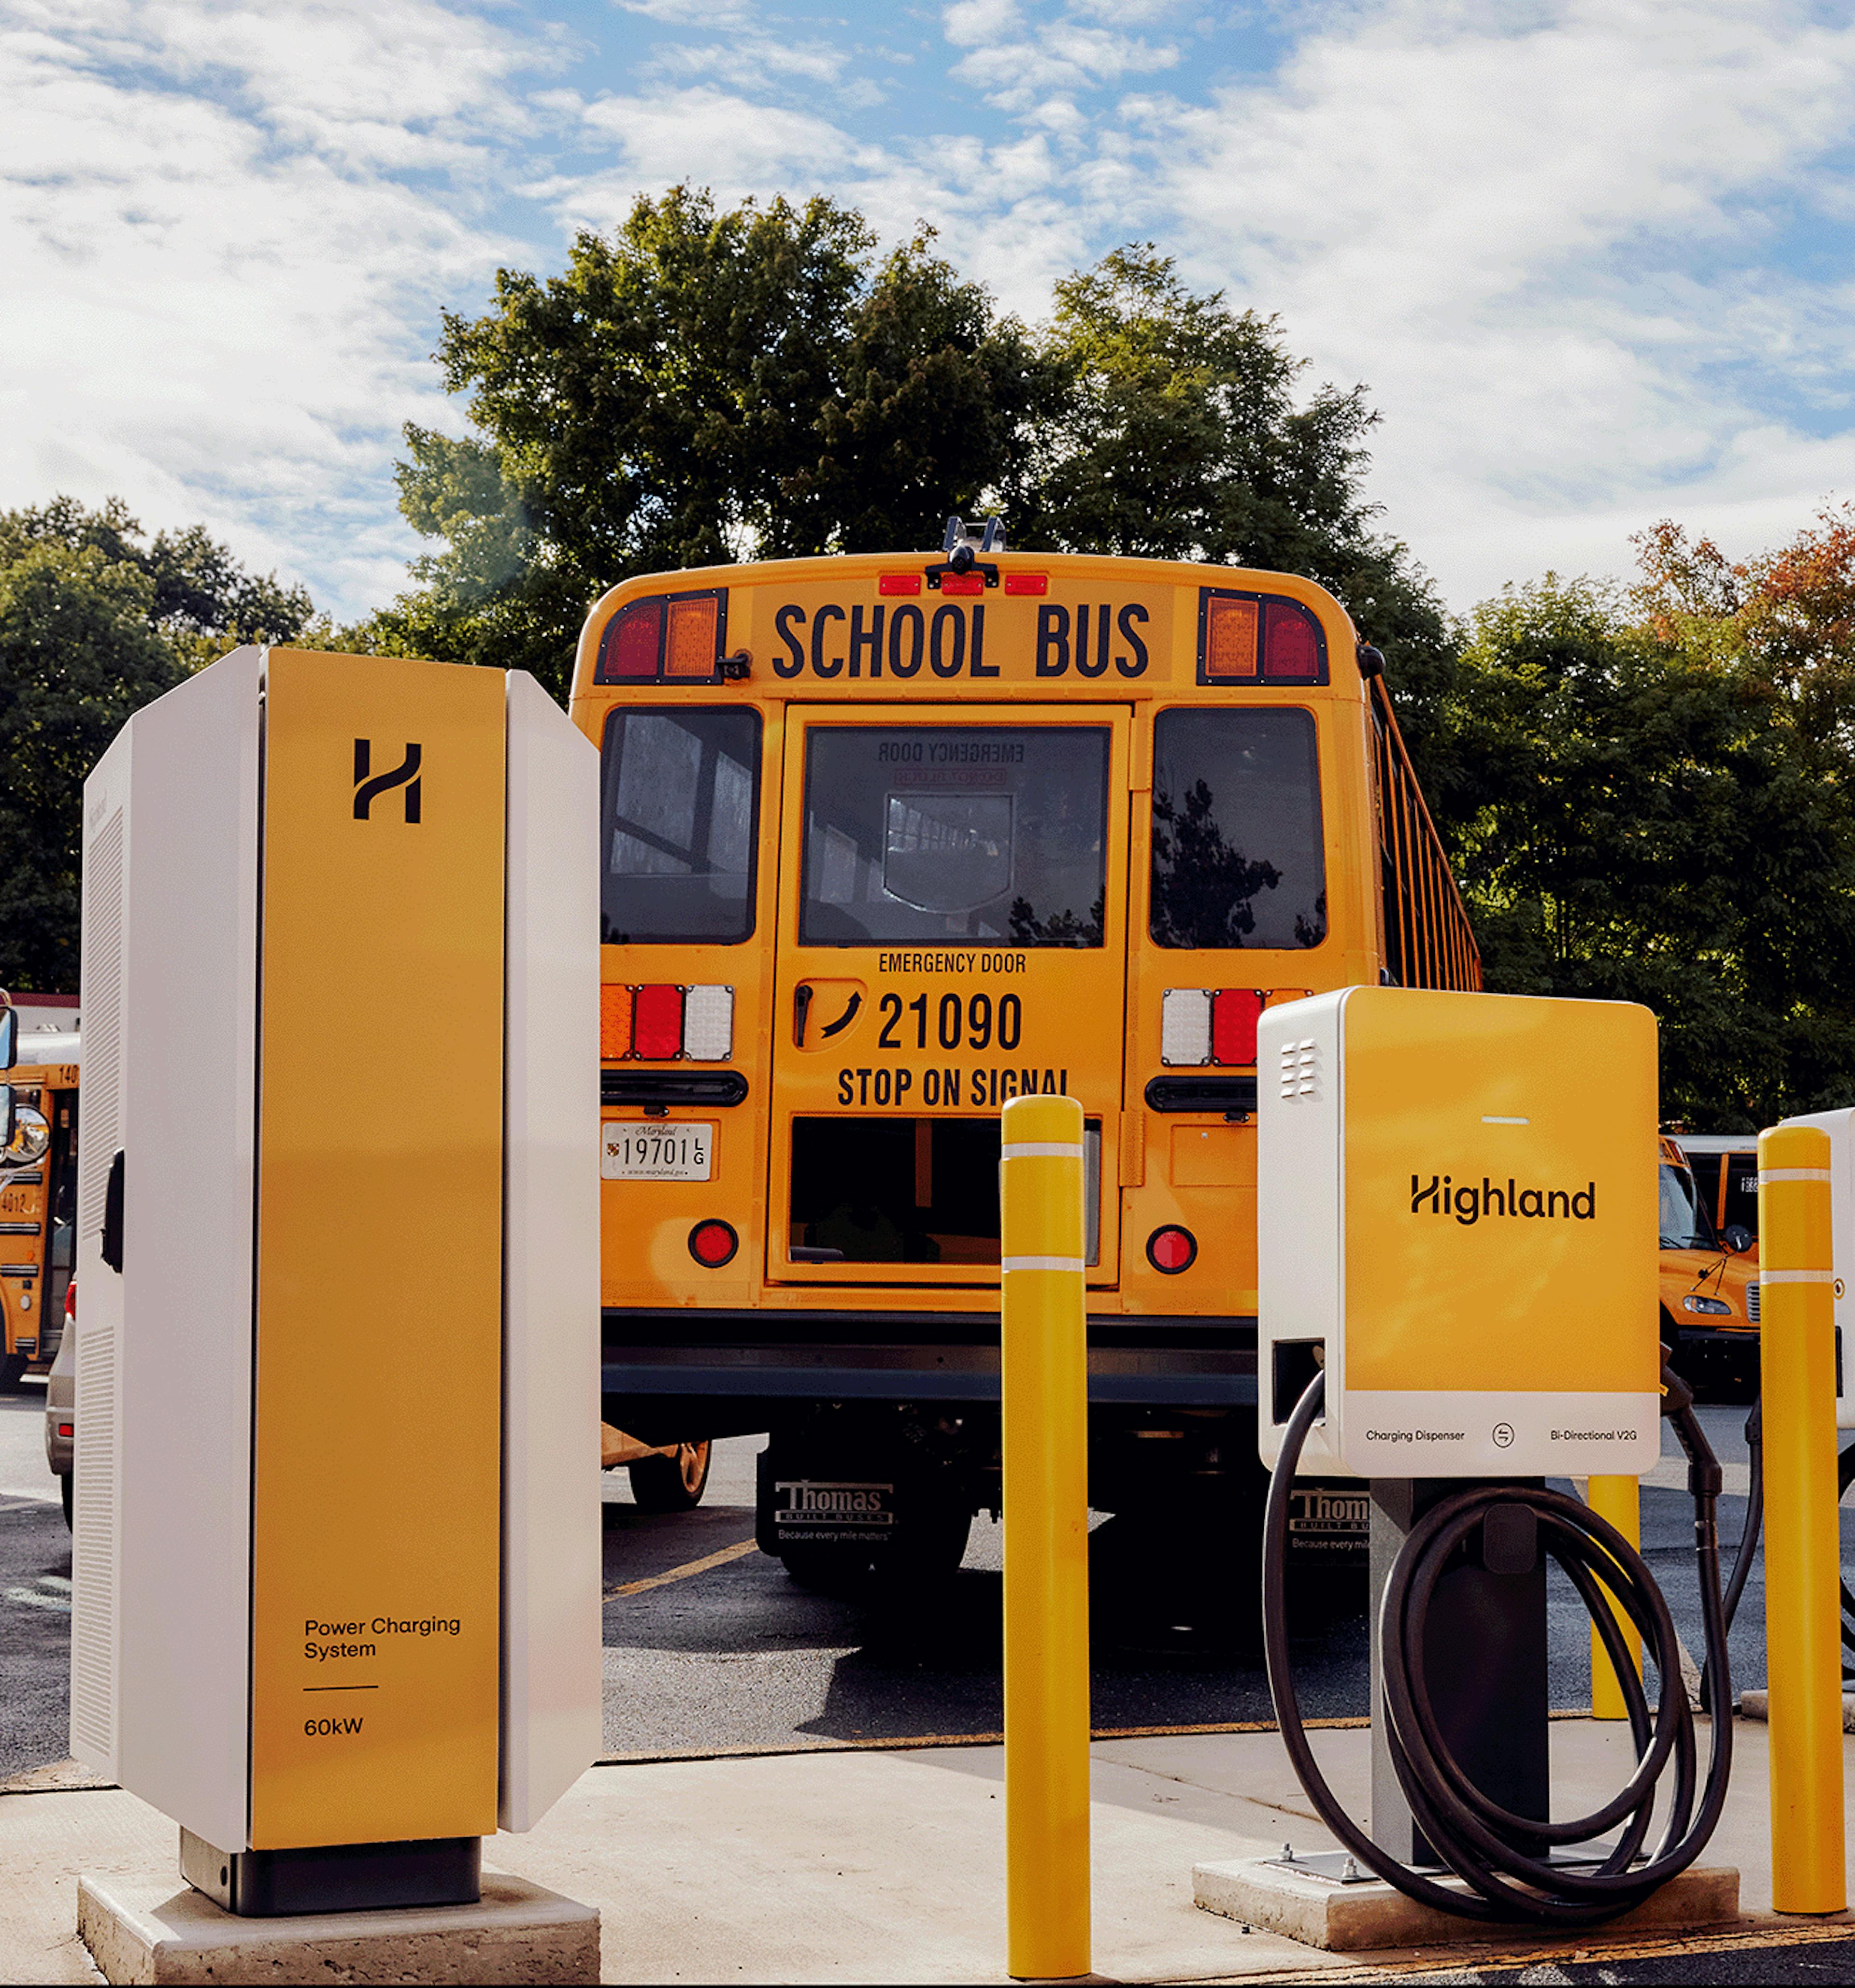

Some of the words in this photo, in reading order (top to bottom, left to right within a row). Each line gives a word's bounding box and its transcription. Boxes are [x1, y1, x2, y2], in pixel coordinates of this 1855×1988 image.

[772, 603, 1000, 679] SCHOOL
[1036, 603, 1149, 678] BUS
[879, 953, 976, 973] EMERGENCY
[982, 953, 1026, 973] DOOR
[879, 993, 1021, 1051] 21090
[838, 1069, 912, 1106] STOP
[923, 1069, 960, 1106] ON
[635, 1125, 676, 1138] Maryland
[625, 1138, 686, 1165] 19701
[1412, 1174, 1596, 1226] Highland
[1366, 1430, 1413, 1443] Charging
[1416, 1430, 1465, 1442] Dispenser
[1551, 1430, 1612, 1441] Bi-Directional
[1617, 1430, 1637, 1441] V2G
[775, 1479, 894, 1511] Thomas
[778, 1529, 814, 1540] Because
[815, 1531, 839, 1542] every
[840, 1530, 858, 1540] mile
[1292, 1538, 1328, 1549] Because
[1329, 1540, 1354, 1551] every
[305, 1620, 366, 1636] Power
[371, 1616, 460, 1636] Charging
[304, 1642, 376, 1662] System
[304, 1717, 363, 1736] 60kW
